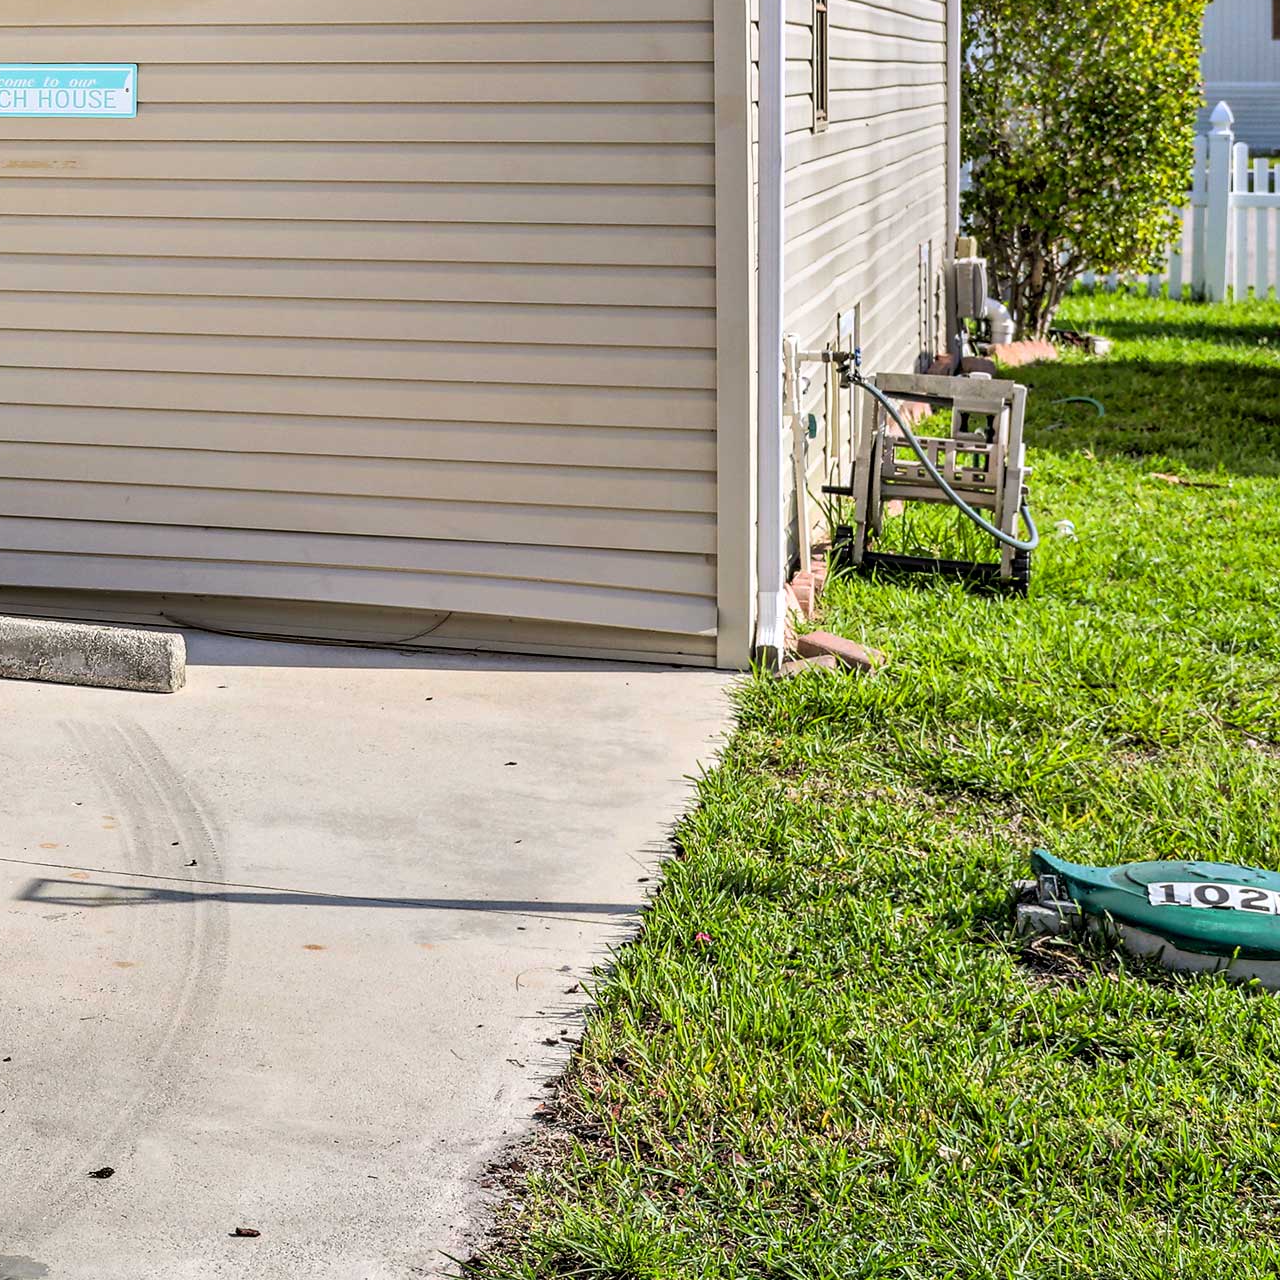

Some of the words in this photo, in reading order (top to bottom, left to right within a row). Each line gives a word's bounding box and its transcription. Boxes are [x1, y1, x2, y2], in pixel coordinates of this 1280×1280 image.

[43, 76, 60, 88] to
[69, 78, 97, 88] our
[38, 89, 117, 109] HOUSE
[1159, 883, 1280, 913] 102
